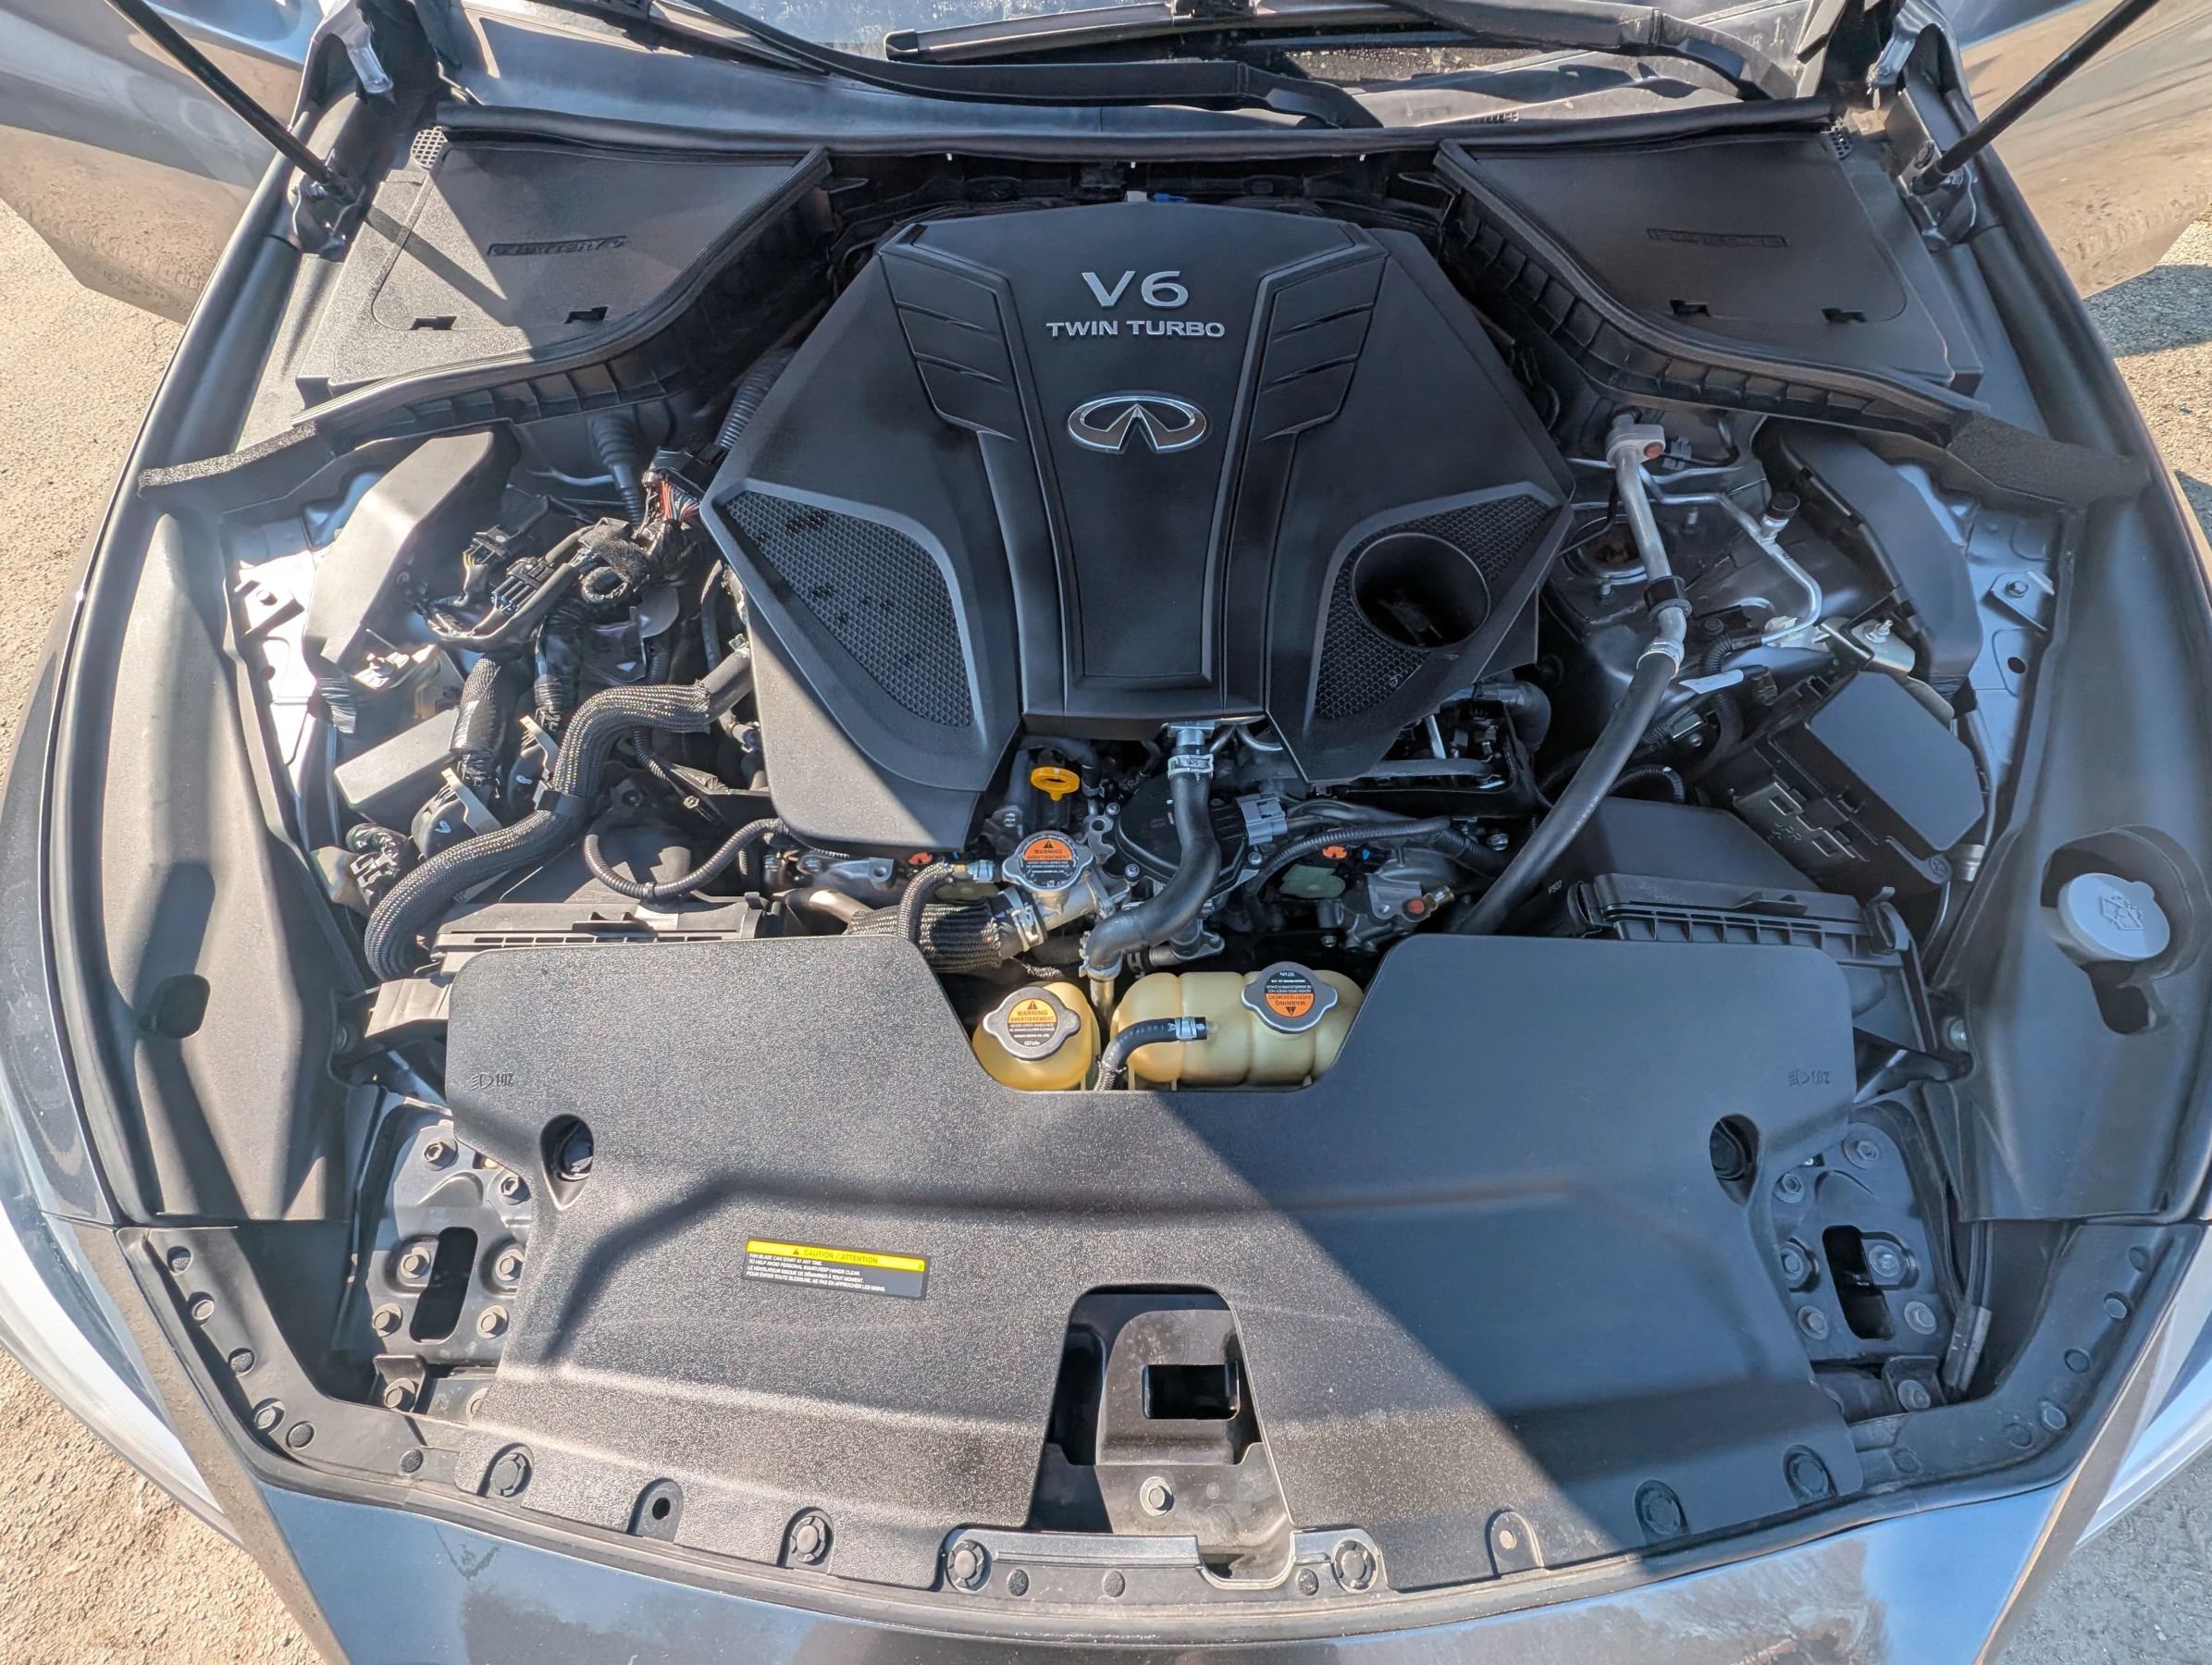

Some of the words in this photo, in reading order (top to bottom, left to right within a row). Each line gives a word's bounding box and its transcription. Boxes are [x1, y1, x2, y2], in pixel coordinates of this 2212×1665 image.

[1081, 270, 1189, 308] V6
[1046, 321, 1118, 338] TWIN
[1126, 320, 1226, 338] TURBO
[804, 1250, 834, 1258] CAUTION
[839, 1254, 878, 1264] ATTENTION
